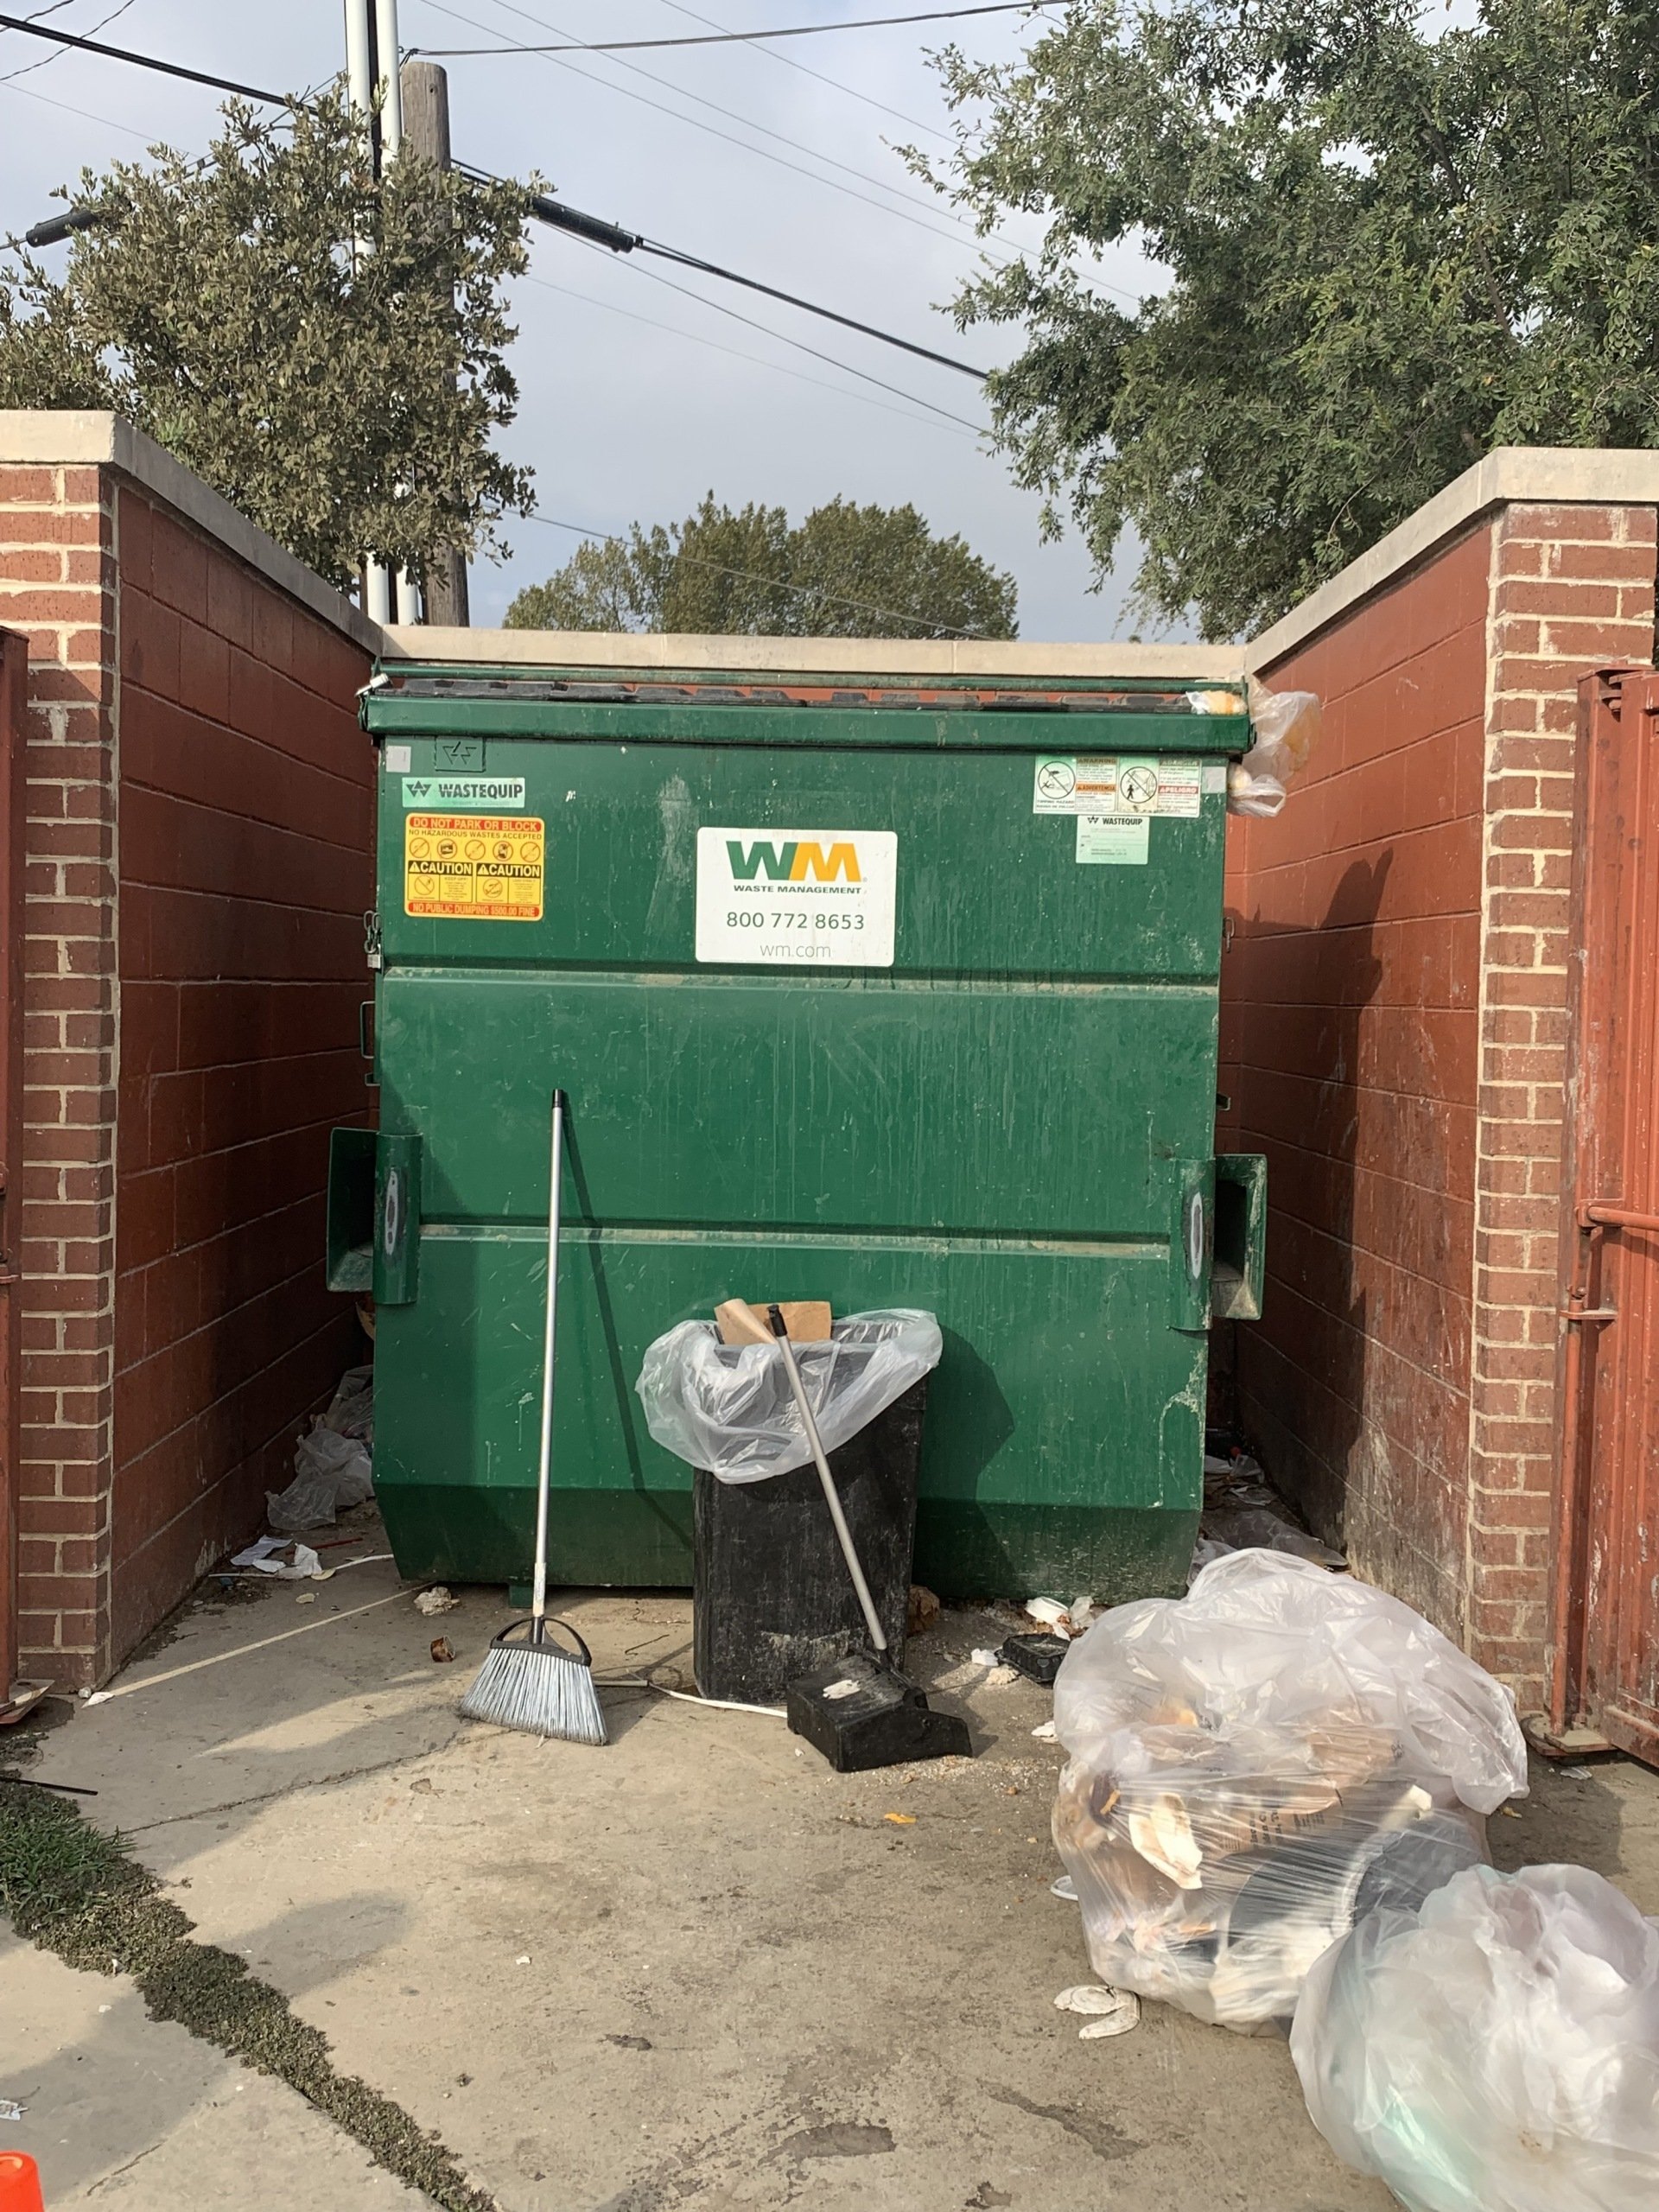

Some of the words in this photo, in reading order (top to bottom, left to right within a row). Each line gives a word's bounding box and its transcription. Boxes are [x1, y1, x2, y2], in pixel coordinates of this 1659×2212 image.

[439, 784, 523, 799] WASTEQUIP
[413, 817, 429, 827] DO
[430, 818, 451, 829] NOT
[454, 819, 481, 830] PARK
[484, 820, 499, 830] OR
[501, 821, 537, 831] BLOCK
[420, 861, 472, 874] CAUTION
[726, 841, 861, 882] WM
[489, 864, 540, 877] CAUTION
[778, 886, 861, 894] MANAGEMENT
[413, 904, 423, 912] NO
[425, 904, 454, 913] PUBLIC
[454, 905, 489, 914] DUMPING
[490, 906, 517, 916] $500.00
[518, 907, 536, 916] FINE
[727, 912, 765, 927] 800
[771, 913, 808, 929] 772
[815, 914, 864, 930] 8653
[760, 945, 831, 958] wm.com
